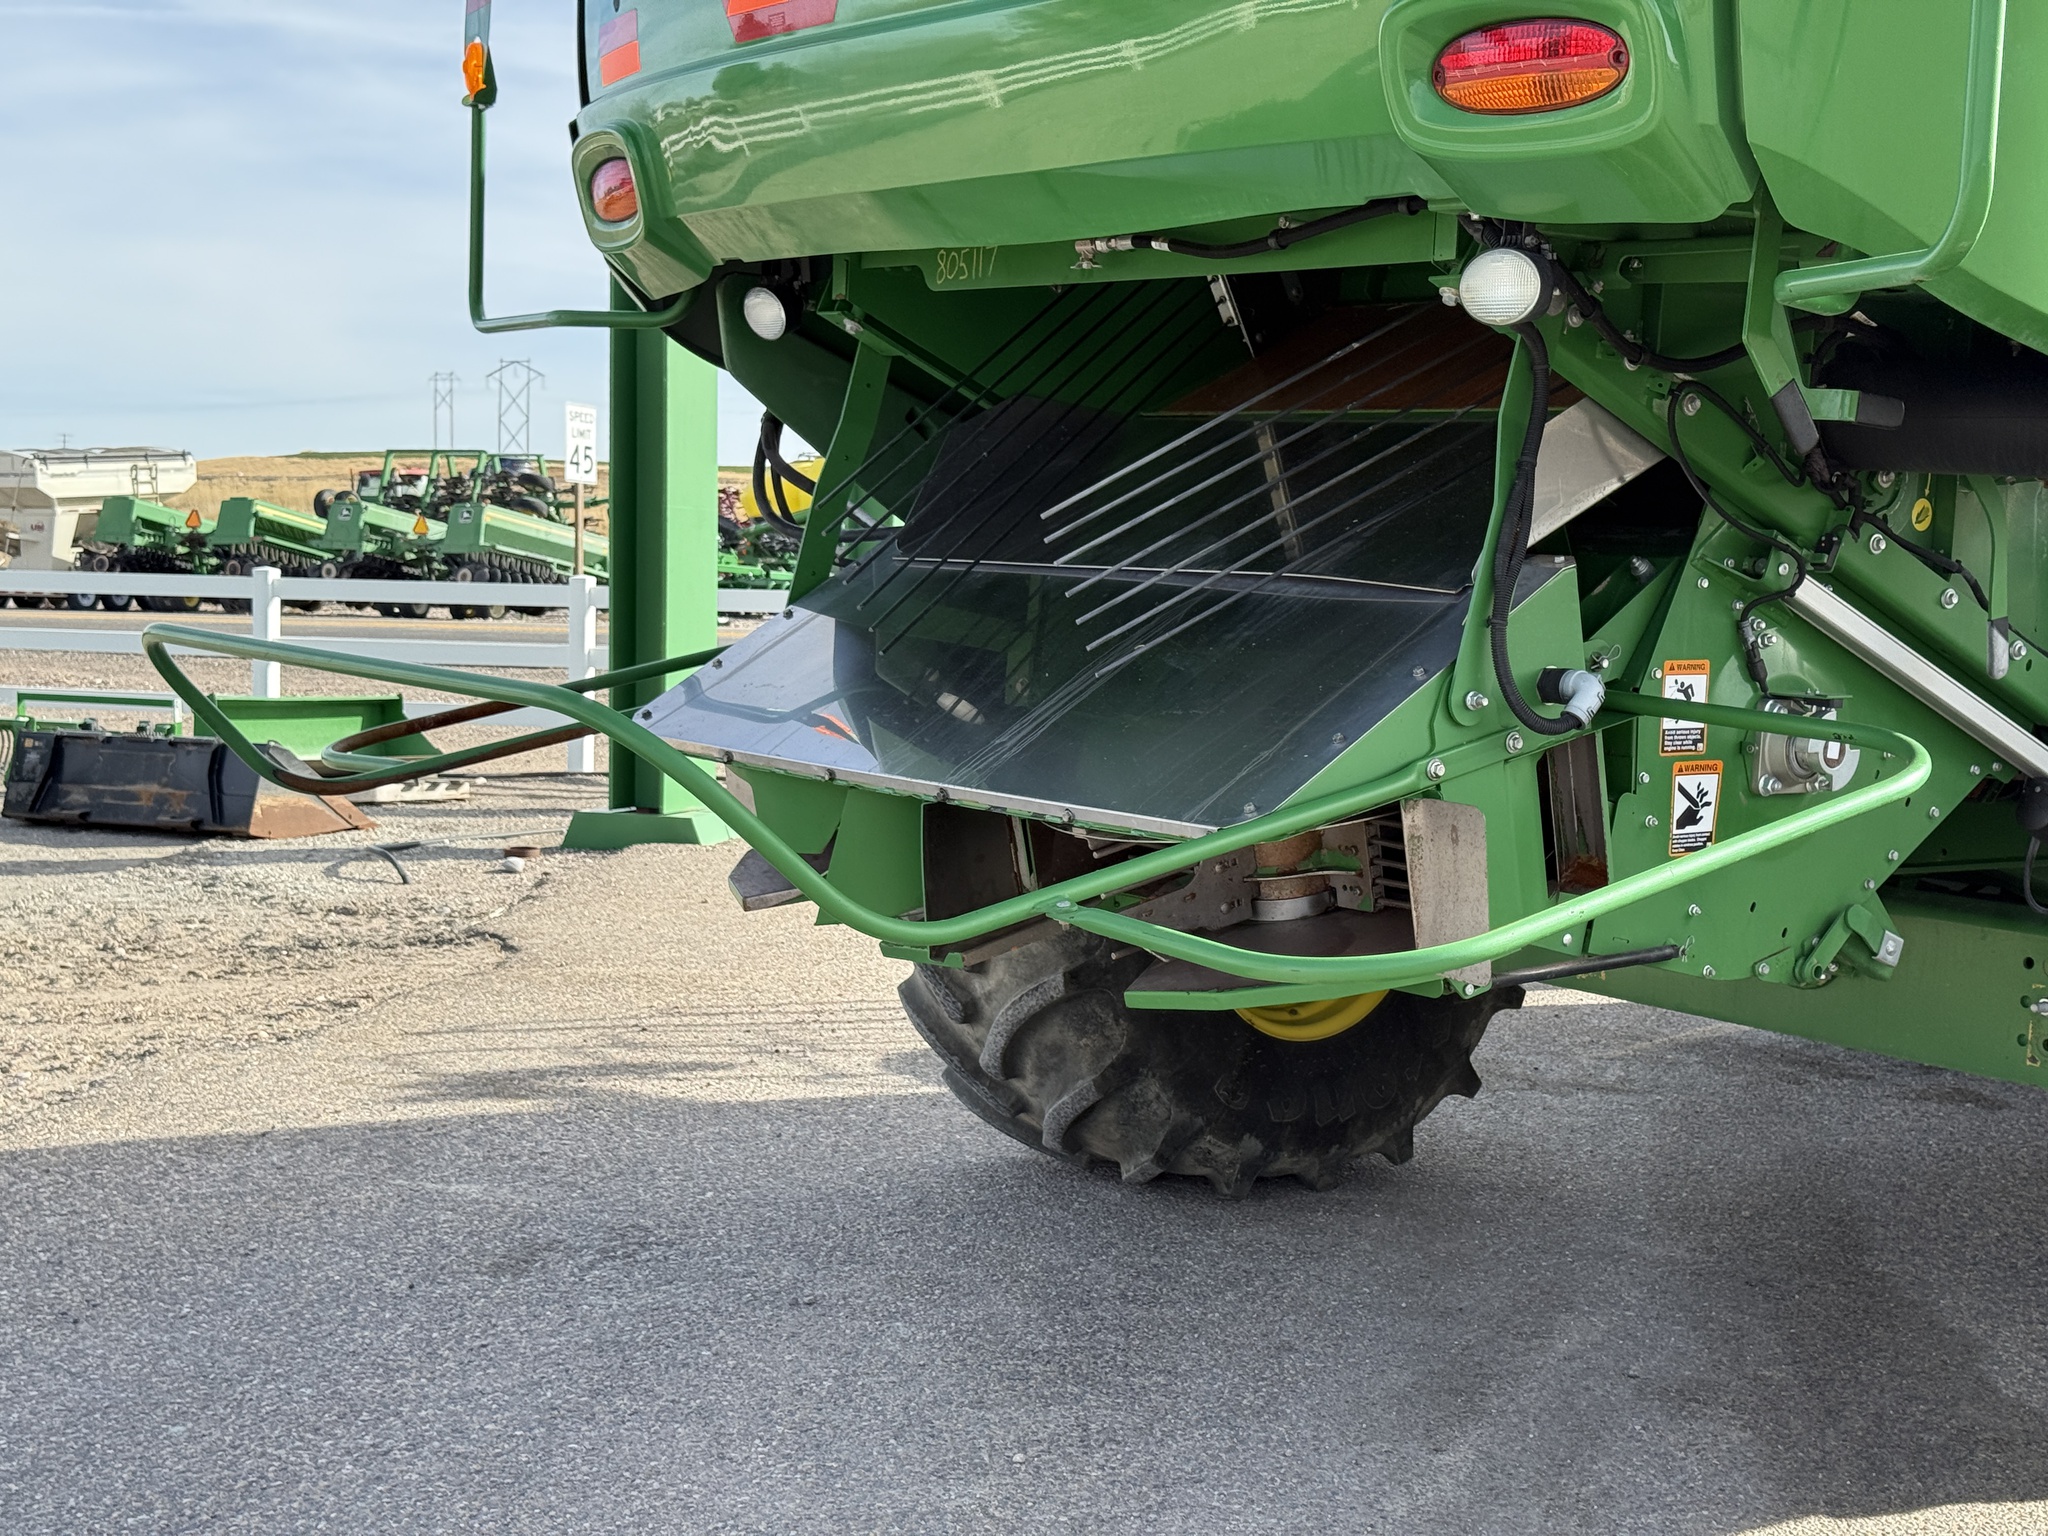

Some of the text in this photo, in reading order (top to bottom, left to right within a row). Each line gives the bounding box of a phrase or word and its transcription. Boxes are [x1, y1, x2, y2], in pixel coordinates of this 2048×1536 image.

[936, 245, 998, 284] 805117
[569, 410, 594, 424] SPEED
[571, 426, 592, 440] LIMIT
[569, 444, 594, 474] 45
[1676, 663, 1706, 671] WARNING
[1684, 763, 1718, 772] WARNING
